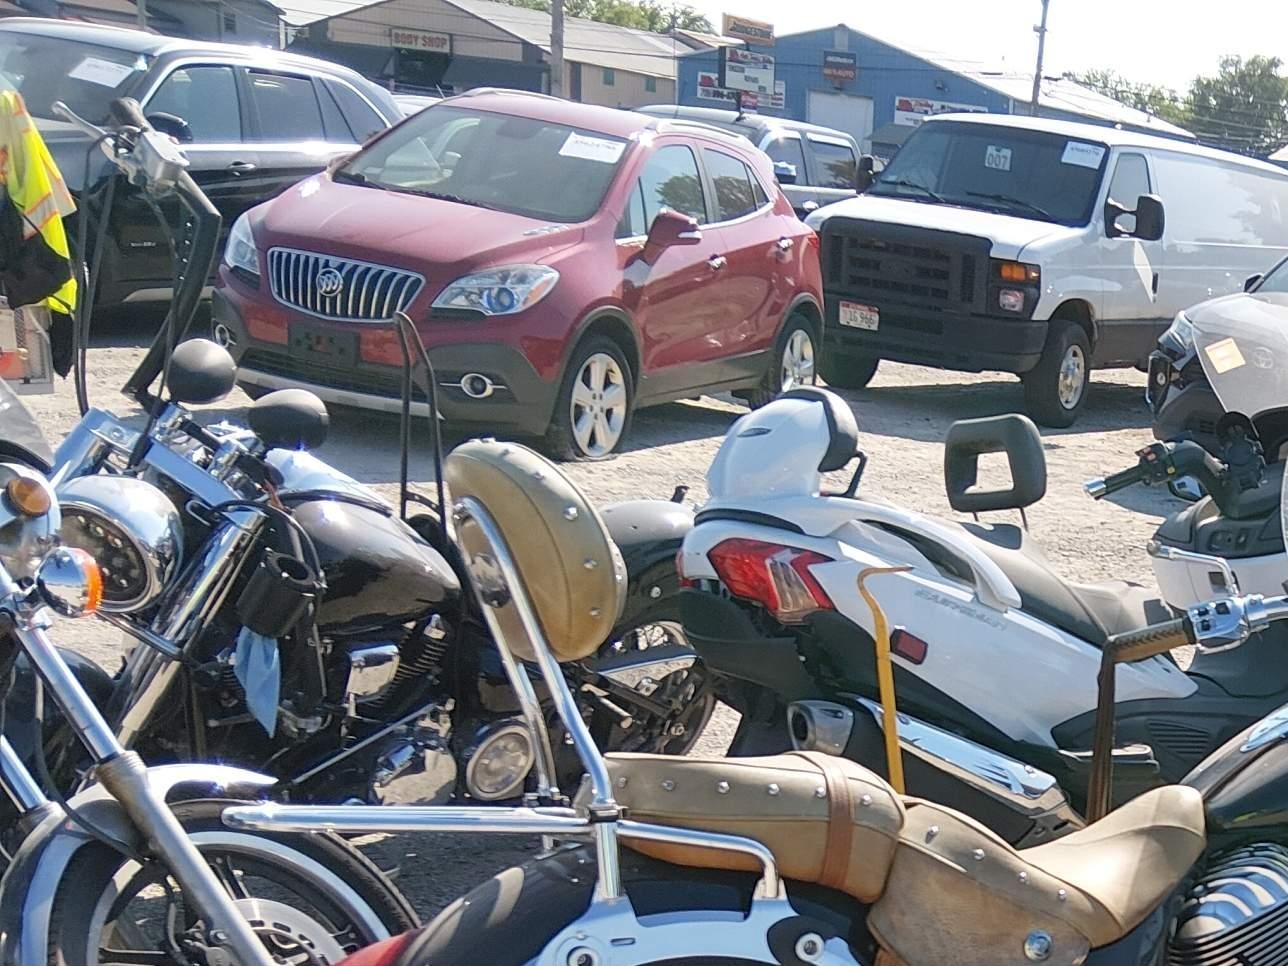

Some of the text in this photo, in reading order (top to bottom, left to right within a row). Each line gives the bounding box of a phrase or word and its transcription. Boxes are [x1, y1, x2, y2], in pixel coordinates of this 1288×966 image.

[394, 32, 447, 48] BODY SHOP
[986, 152, 1008, 169] 007
